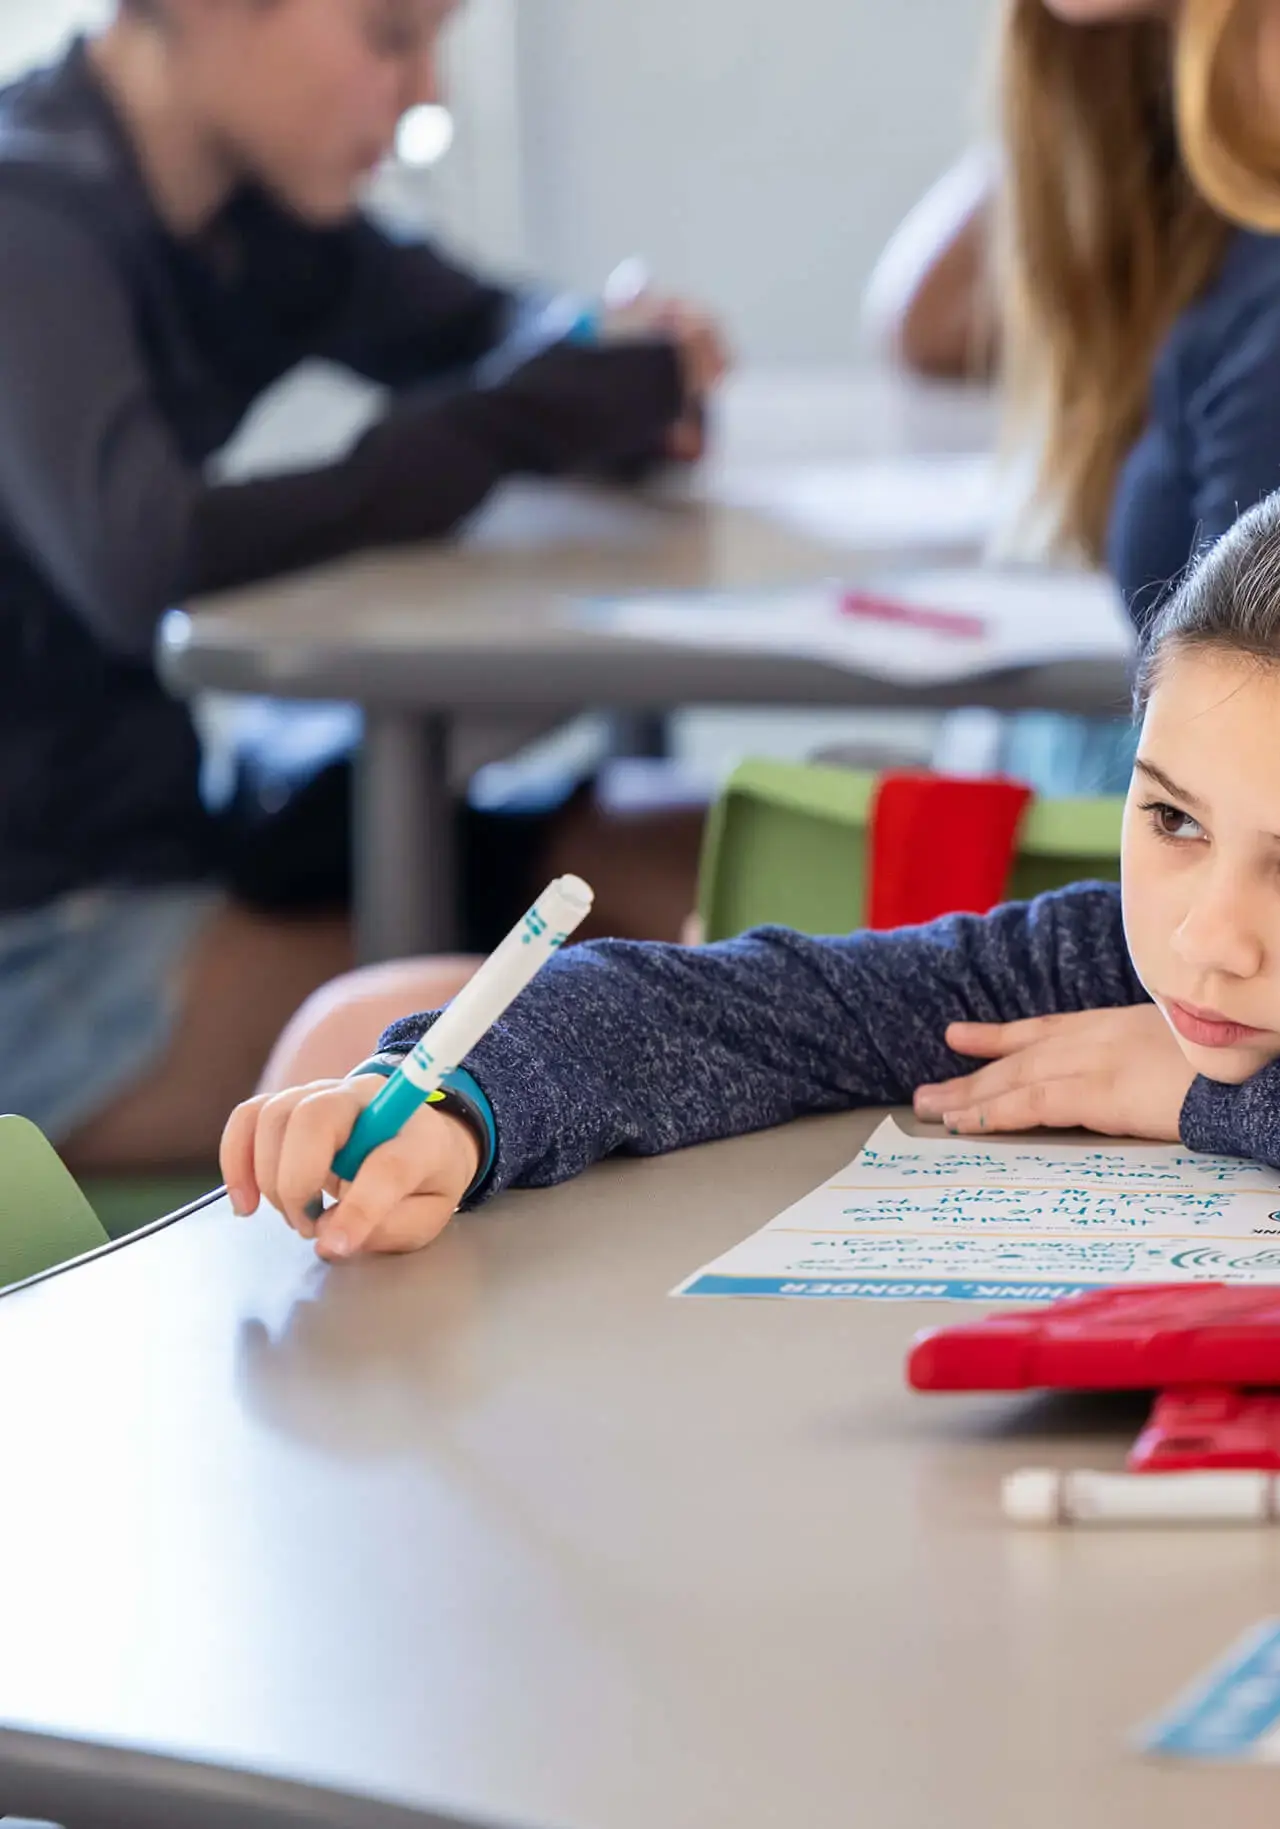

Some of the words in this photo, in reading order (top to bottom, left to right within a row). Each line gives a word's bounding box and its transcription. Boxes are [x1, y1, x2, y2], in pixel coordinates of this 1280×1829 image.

[1053, 1169, 1181, 1180] wonder
[1007, 1206, 1116, 1216] brave
[1144, 1208, 1223, 1217] very
[780, 1282, 948, 1295] WONDER
